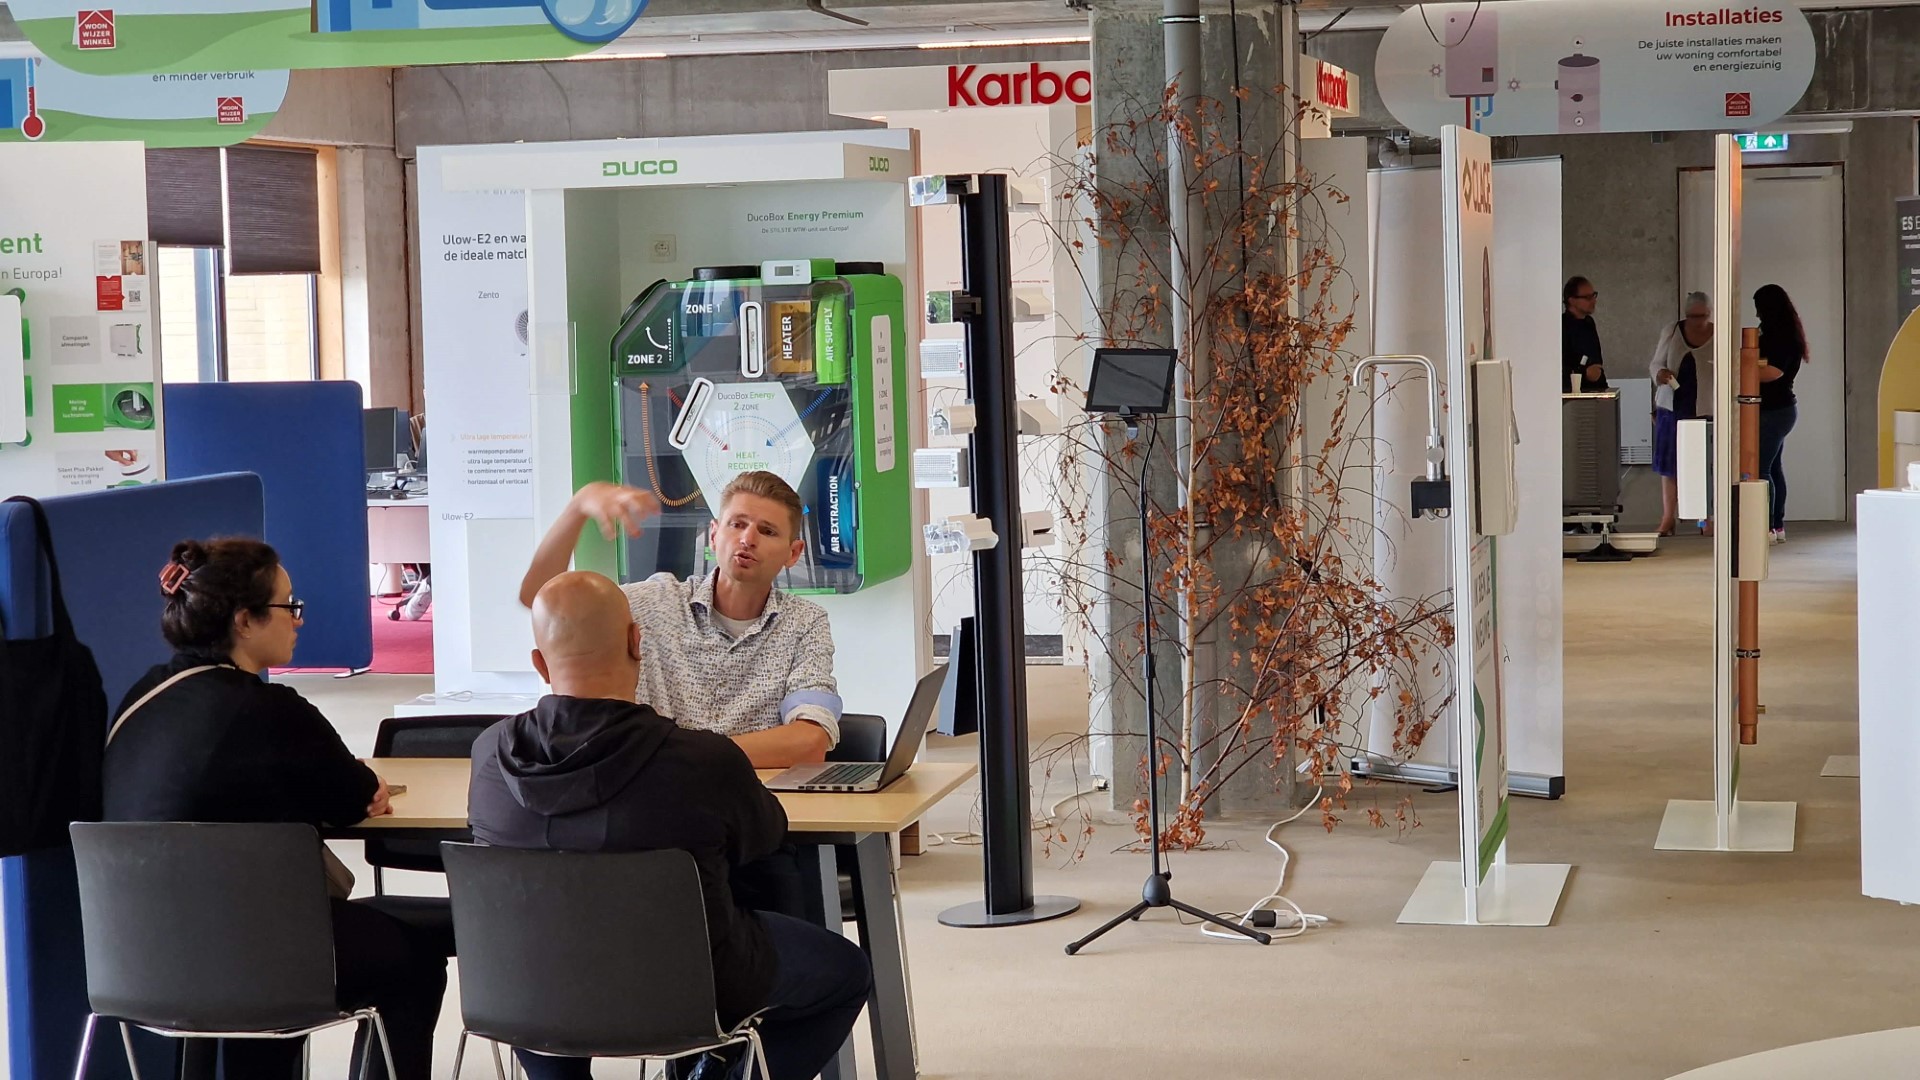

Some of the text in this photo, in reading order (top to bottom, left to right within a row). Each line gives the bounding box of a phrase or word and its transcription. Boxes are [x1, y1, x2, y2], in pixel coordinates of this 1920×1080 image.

[1666, 7, 1783, 27] Installaties
[82, 38, 112, 46] WINKEL
[1638, 35, 1782, 50] De juiste installaties maken
[1675, 51, 1714, 61] woning
[1717, 48, 1782, 59] comfortabel
[1693, 60, 1782, 72] en energiezuinig
[152, 70, 255, 82] en minder verbruik
[947, 63, 1091, 107] Karbo
[602, 160, 678, 176] DUCO
[869, 156, 889, 172] DUCO
[747, 210, 864, 222] DucoBox Energy Premium
[0, 233, 43, 254] ent
[442, 233, 491, 245] Ulow-E2
[494, 235, 508, 244] en
[444, 250, 458, 261] de
[460, 249, 494, 261] ideale
[13, 267, 62, 282] Europa!
[478, 291, 500, 299] Zento
[686, 304, 721, 314] ZONE 1
[781, 315, 792, 360] HEATER
[824, 307, 835, 362] AIR SUPPLY
[627, 354, 663, 364] ZONE 2
[717, 391, 776, 400] DucoBox Energy
[728, 462, 770, 470] RECOVERY
[442, 512, 474, 520] Ulow-E2
[829, 475, 841, 553] AIR EXTRACTION
